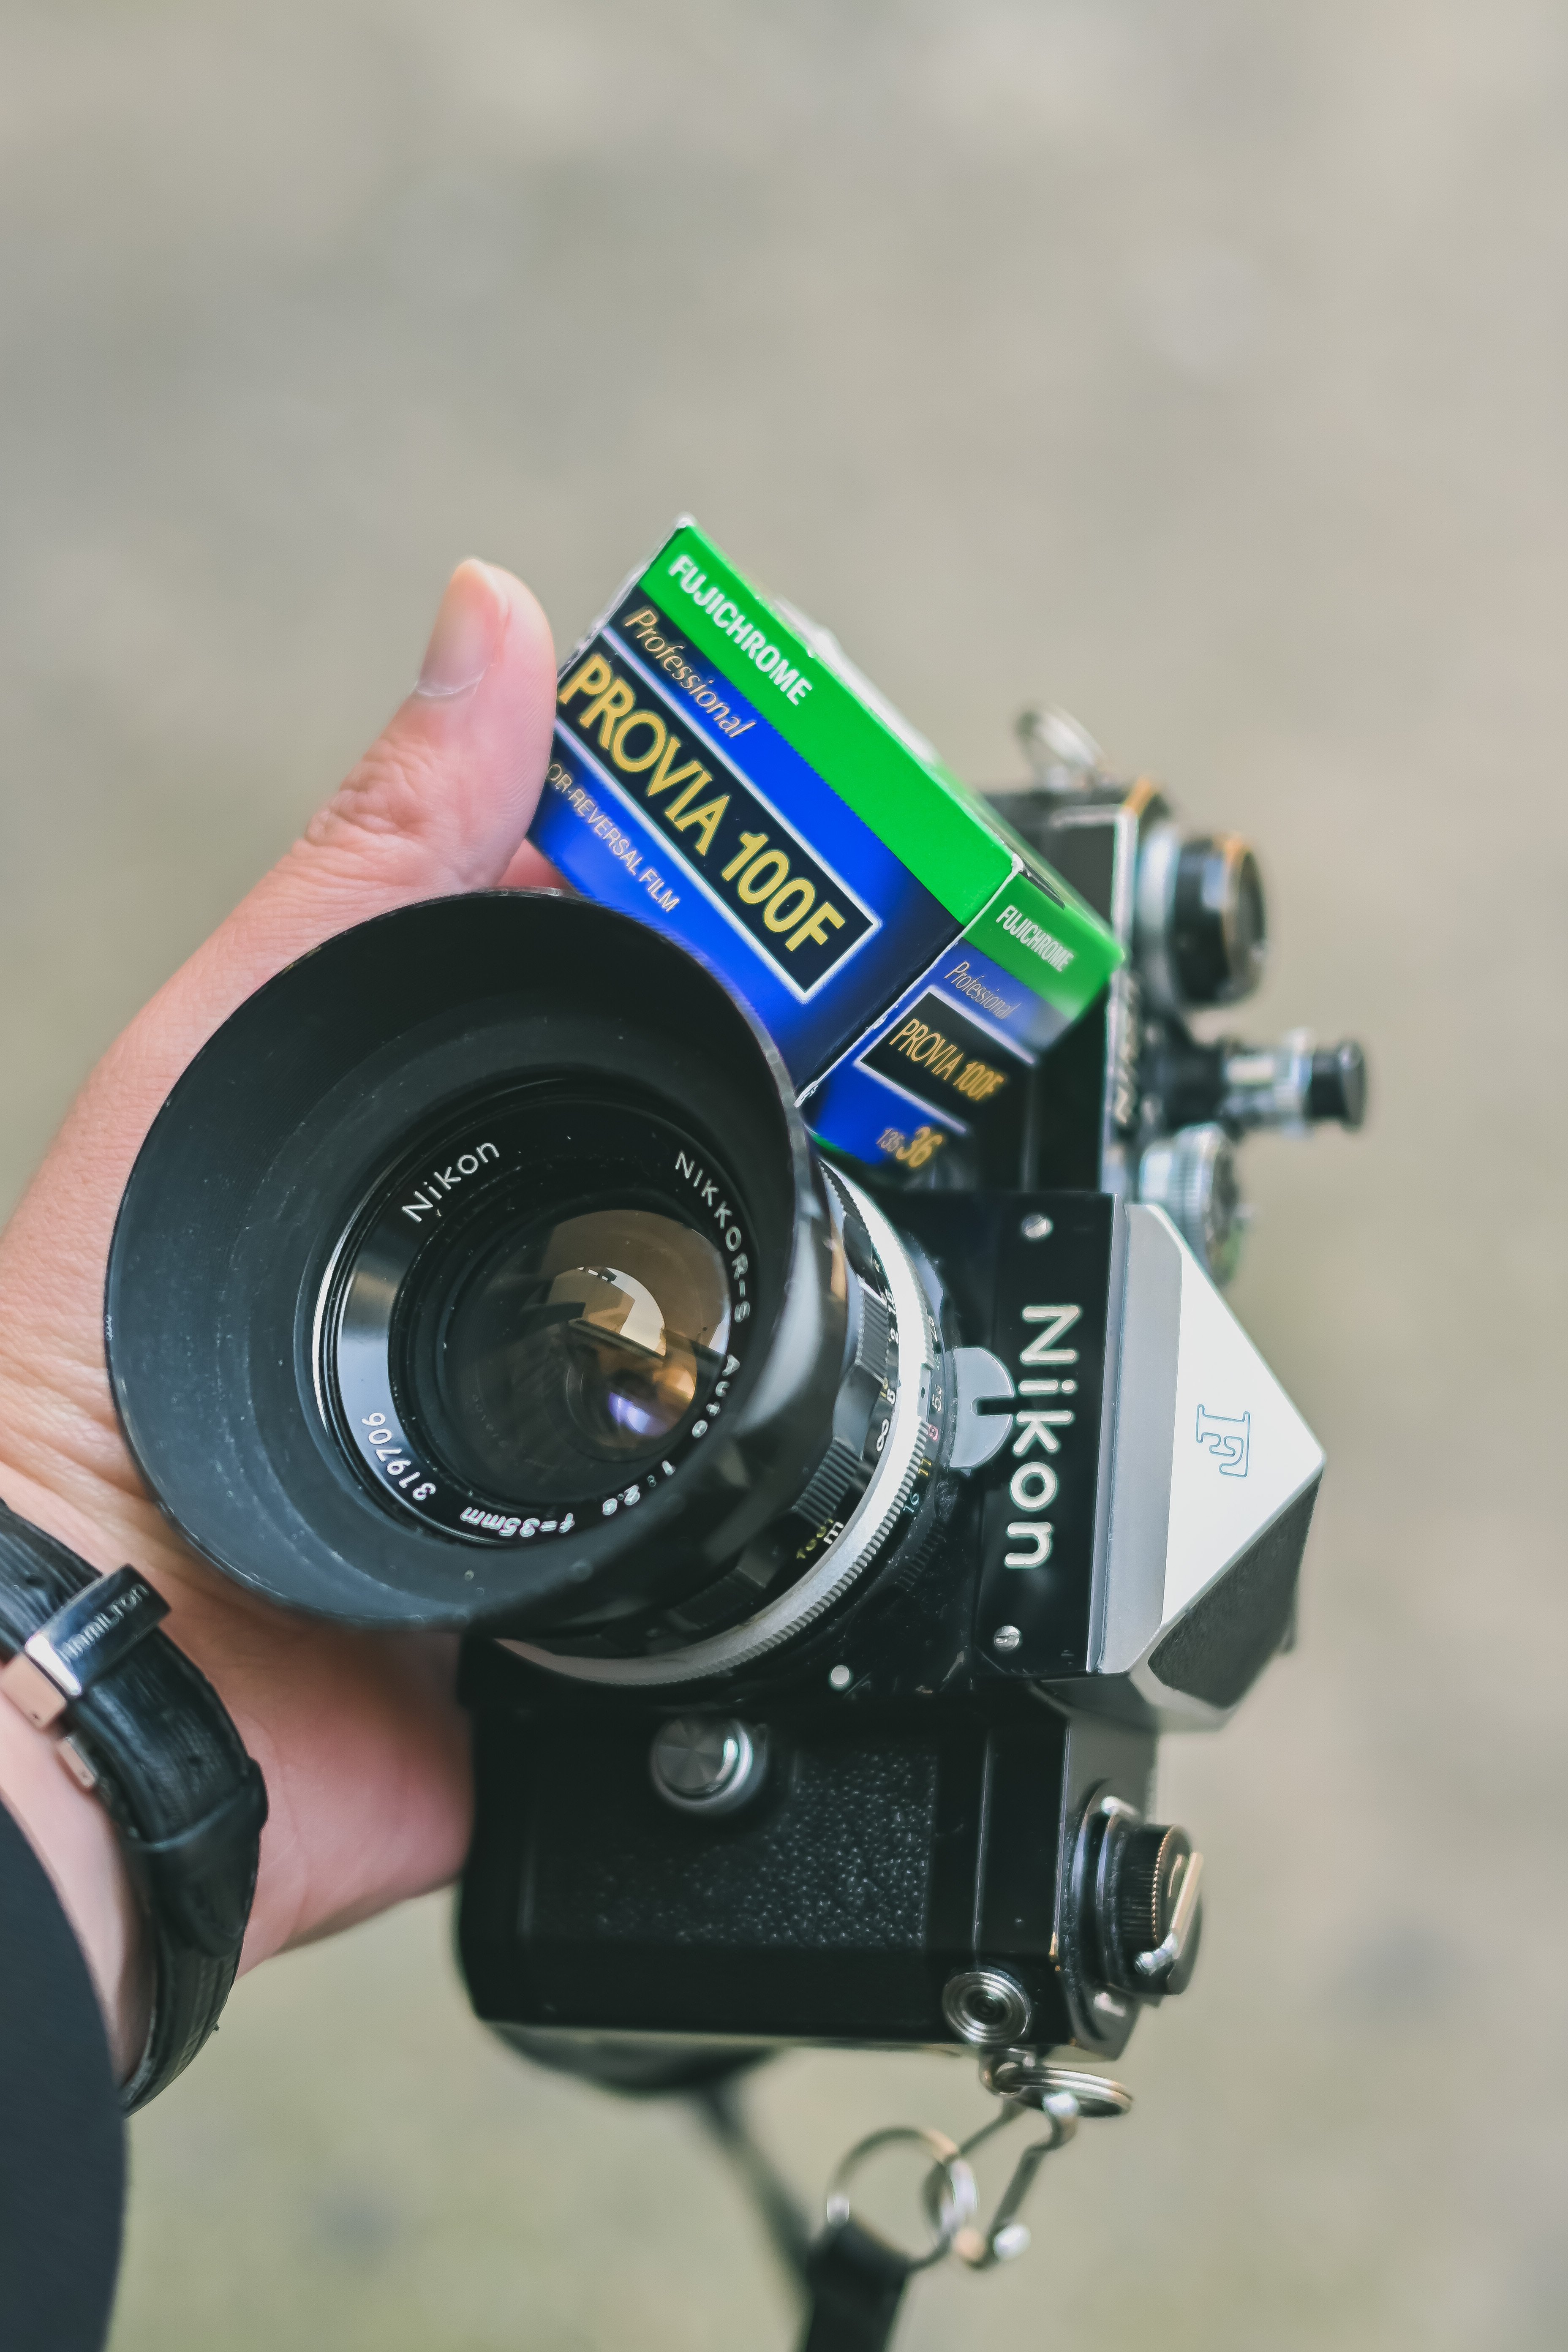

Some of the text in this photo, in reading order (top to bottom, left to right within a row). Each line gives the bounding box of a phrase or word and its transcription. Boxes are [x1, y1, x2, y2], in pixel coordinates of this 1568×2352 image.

[668, 555, 813, 706] FUJICHROME
[624, 607, 756, 738] Professional
[558, 653, 845, 951] PROVIA 100F
[639, 868, 680, 912] FILM
[995, 905, 1074, 972] FUJICHROME
[944, 961, 1021, 1019] Professional
[889, 1018, 1004, 1101] PROVIA 100F
[402, 1140, 500, 1222] Nikon
[675, 1151, 750, 1323] NIKKOR-S
[361, 1412, 437, 1501] 319706
[1004, 1304, 1081, 1568] Nikon
[1195, 1404, 1251, 1478] F
[903, 1492, 920, 1514] 16
